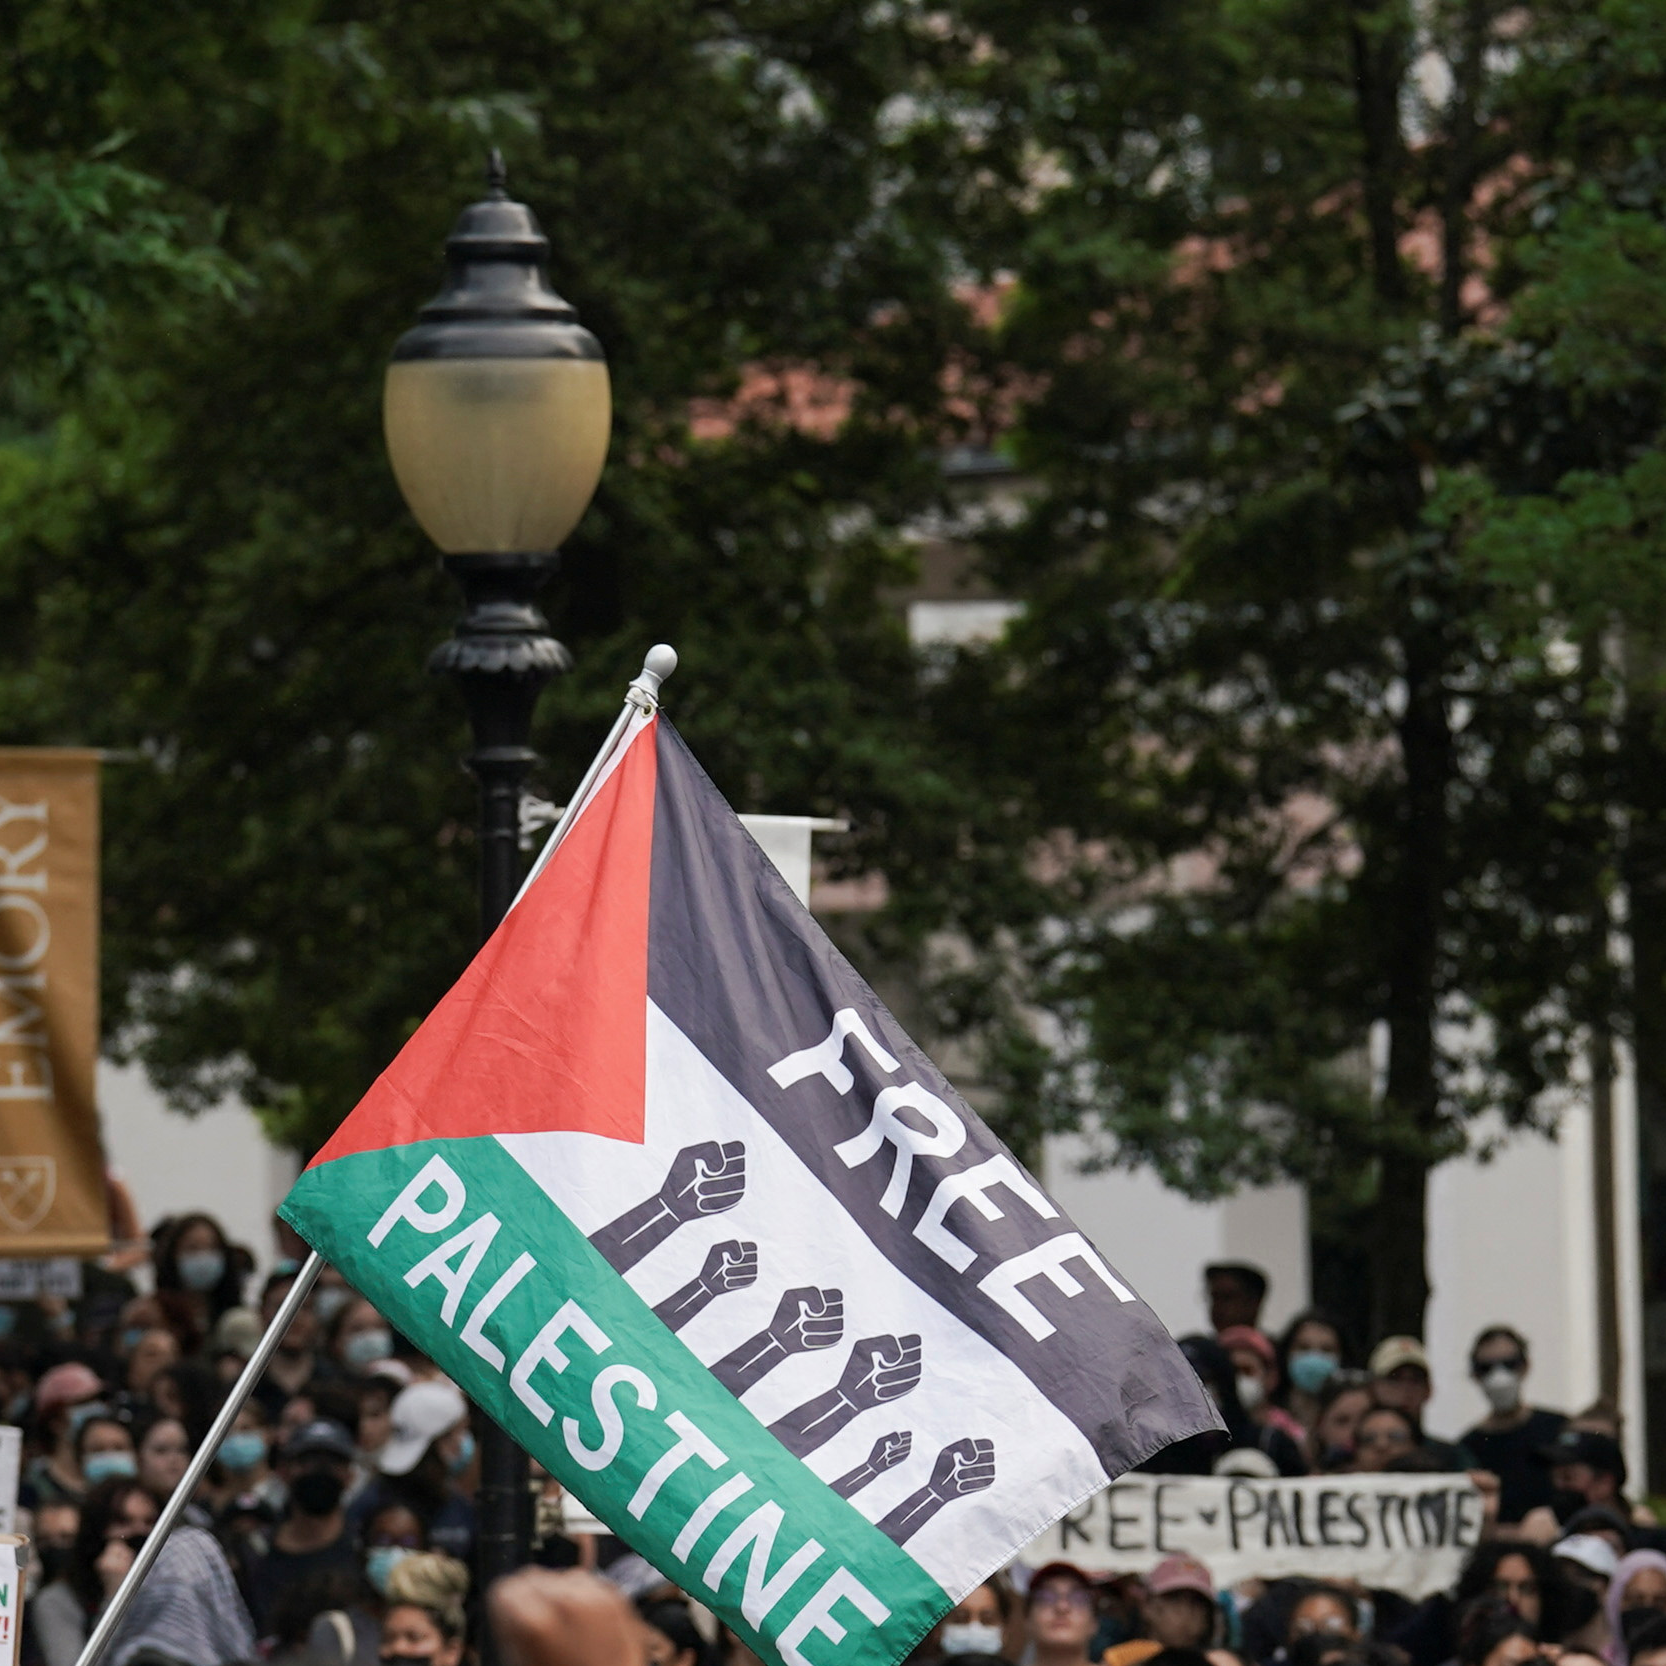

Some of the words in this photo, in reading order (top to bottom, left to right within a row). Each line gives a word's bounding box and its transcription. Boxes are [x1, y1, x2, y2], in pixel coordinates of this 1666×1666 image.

[766, 1006, 1137, 1343] FREE
[1059, 1483, 1185, 1552] REE
[1227, 1476, 1482, 1552] PALESTINE
